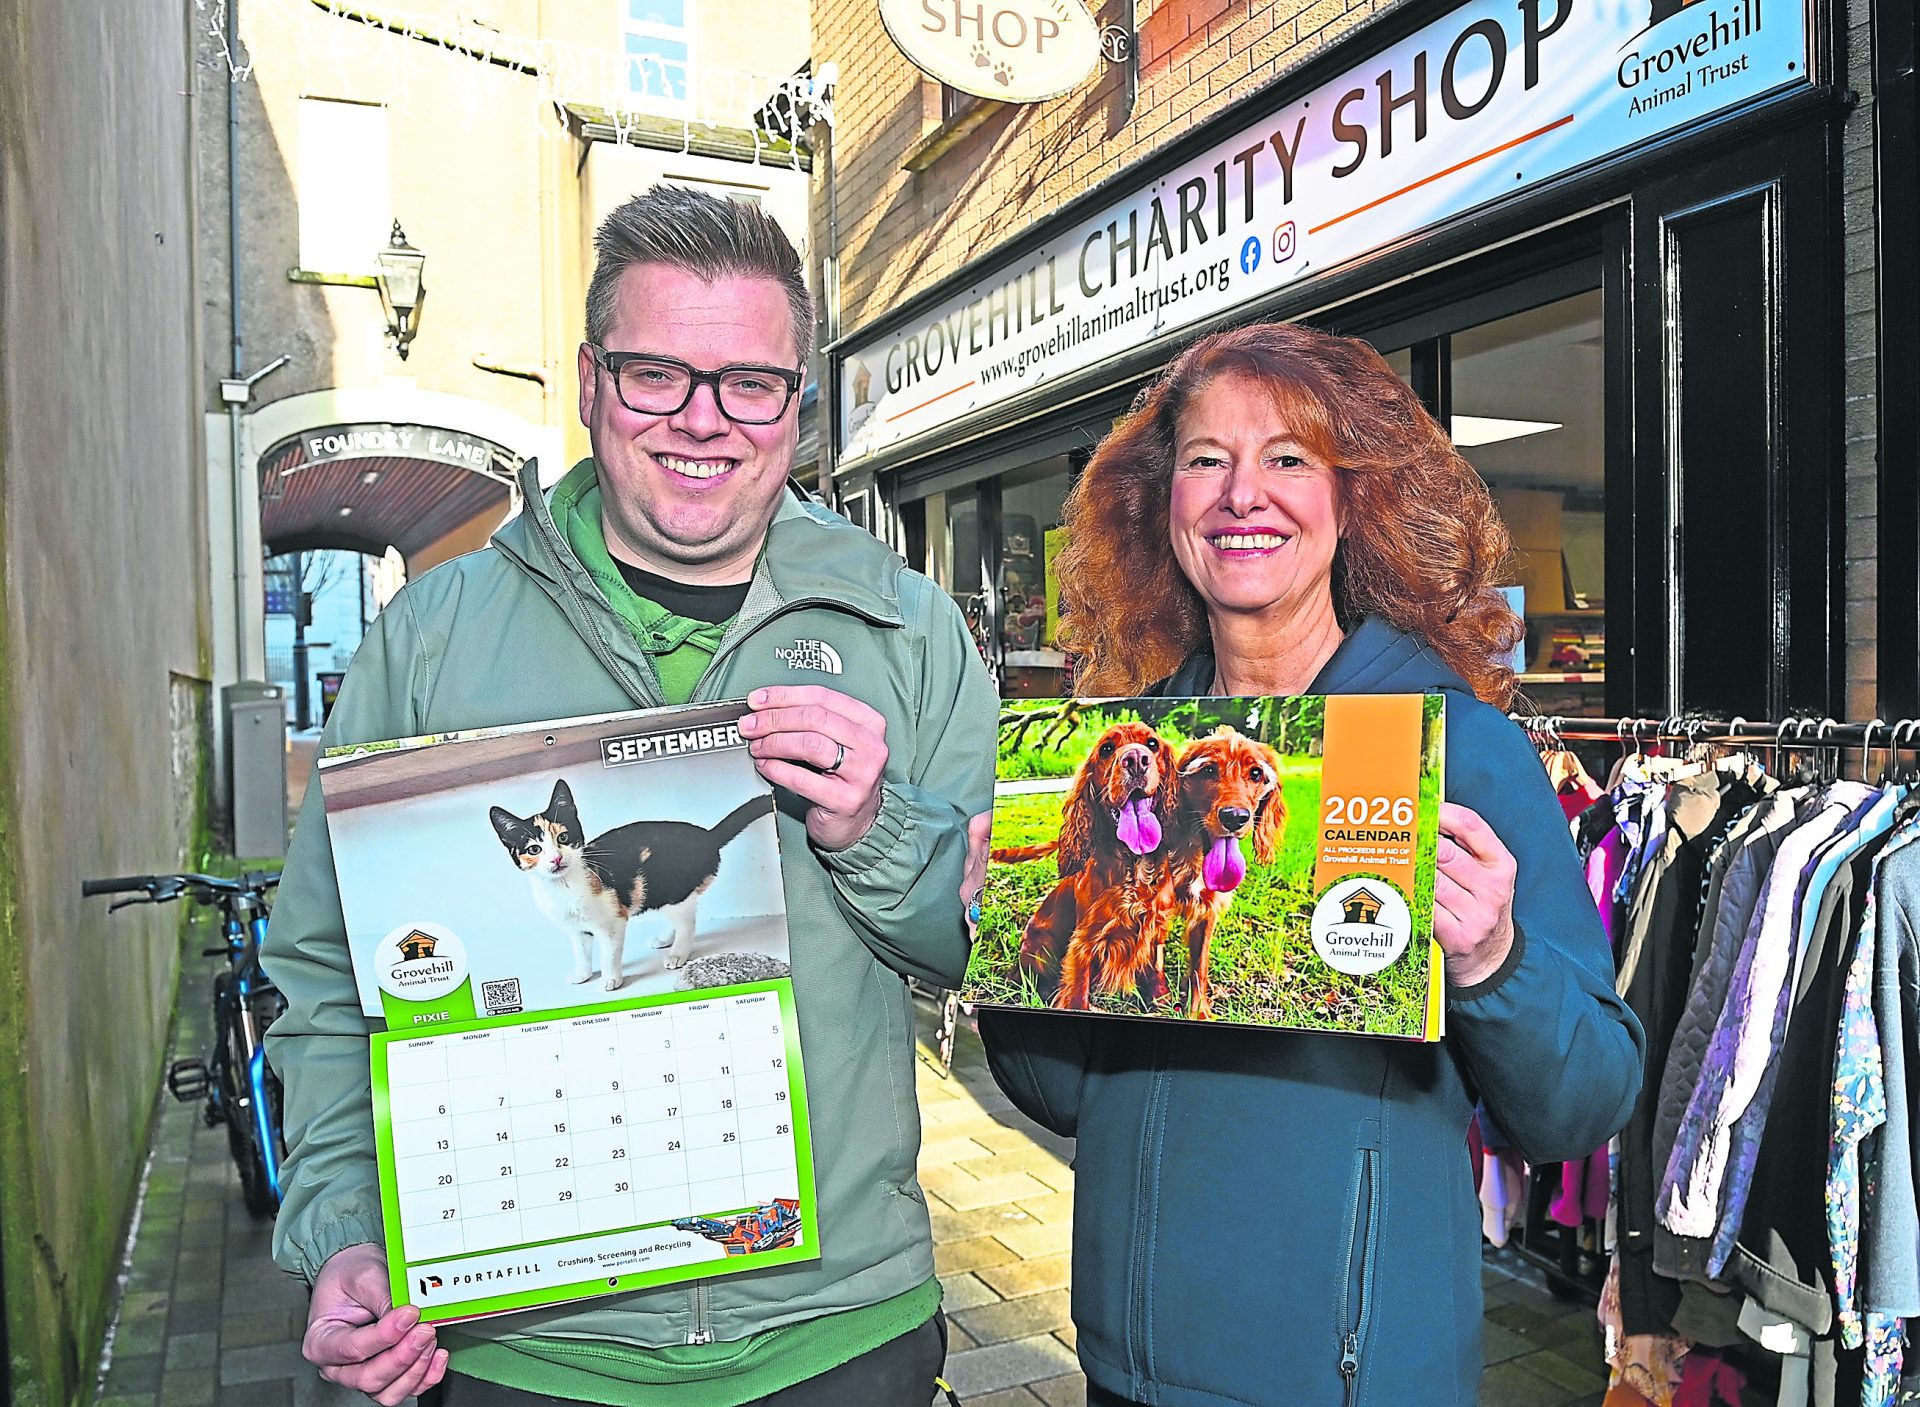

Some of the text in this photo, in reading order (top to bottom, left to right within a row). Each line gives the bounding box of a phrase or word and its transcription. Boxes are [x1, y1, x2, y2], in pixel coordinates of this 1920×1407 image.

[921, 0, 1060, 53] SHOP
[1617, 0, 1761, 89] Grovehill
[1628, 53, 1749, 118] Animal Trust
[885, 0, 1572, 394] GROVEHILL CHARITY SHOP
[980, 256, 1230, 386] www.grovehillanimaltrust.org
[309, 431, 486, 465] FOUNDRY LANE
[775, 647, 820, 660] NORTH
[794, 639, 820, 650] THE
[788, 658, 821, 671] FACE
[607, 725, 743, 763] SEPTEMBER
[1324, 796, 1414, 826] 2026
[1324, 829, 1411, 843] CALENDAR
[1323, 855, 1410, 865] Grovehill Animal Trust
[1325, 931, 1394, 948] Grovehill
[1329, 948, 1386, 959] Animal Trust
[391, 960, 454, 980] Grovehill
[398, 975, 450, 987] Animal Trust
[408, 1040, 434, 1049] SUNDAY
[463, 1032, 491, 1041] MONDAY
[520, 1025, 549, 1033] TUESDAY
[572, 1017, 611, 1026] WEDNESDAY
[630, 1010, 663, 1019] THURSDAY
[735, 996, 766, 1006] SATURDAY
[413, 1011, 450, 1025] PIXIE
[772, 1025, 779, 1035] 5
[438, 1058, 783, 1115] 6 7 8 9 10 11 12
[437, 1091, 786, 1150] 13 14 15 16 17 18 19
[438, 1124, 789, 1186] 20 21 22 23 24 25 26
[442, 1181, 629, 1220] 27 28 29 30
[557, 1240, 692, 1268] Crushing, Screening and Recycling
[453, 1263, 541, 1286] PORTAFILL
